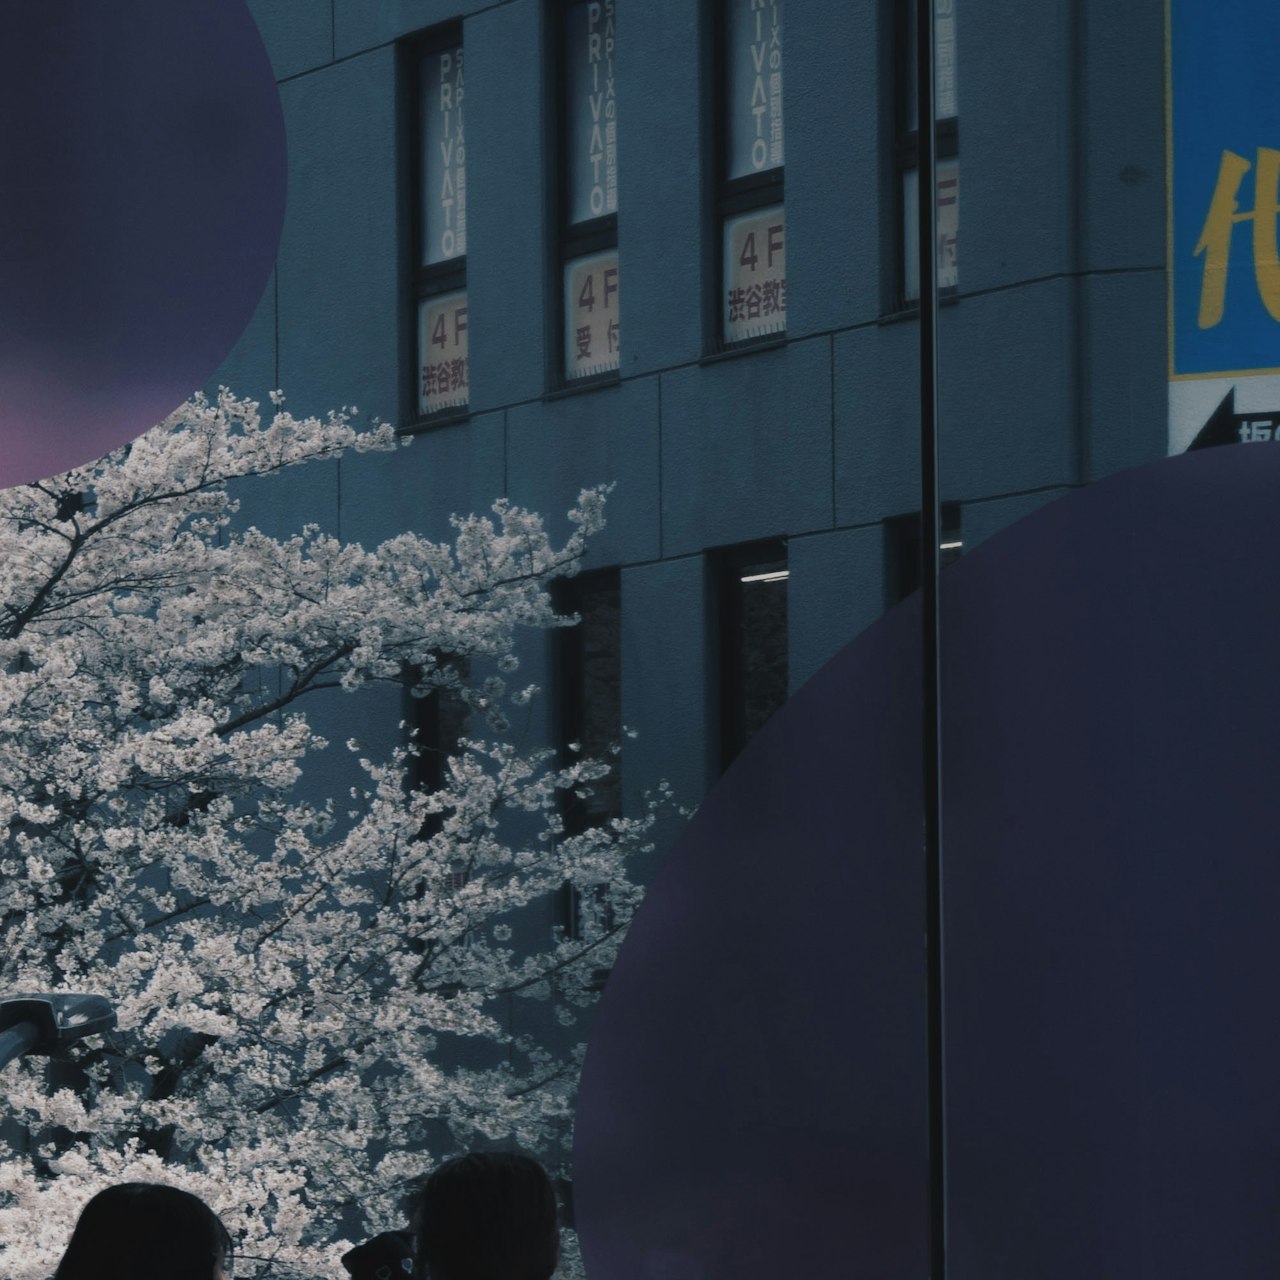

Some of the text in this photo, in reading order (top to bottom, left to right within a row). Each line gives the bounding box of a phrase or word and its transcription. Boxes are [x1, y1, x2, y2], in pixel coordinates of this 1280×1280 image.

[741, 223, 784, 272] 4F
[579, 267, 618, 313] 4F
[728, 278, 787, 323] 渋谷教
[432, 307, 468, 350] 4F
[422, 356, 469, 397] 渋谷教
